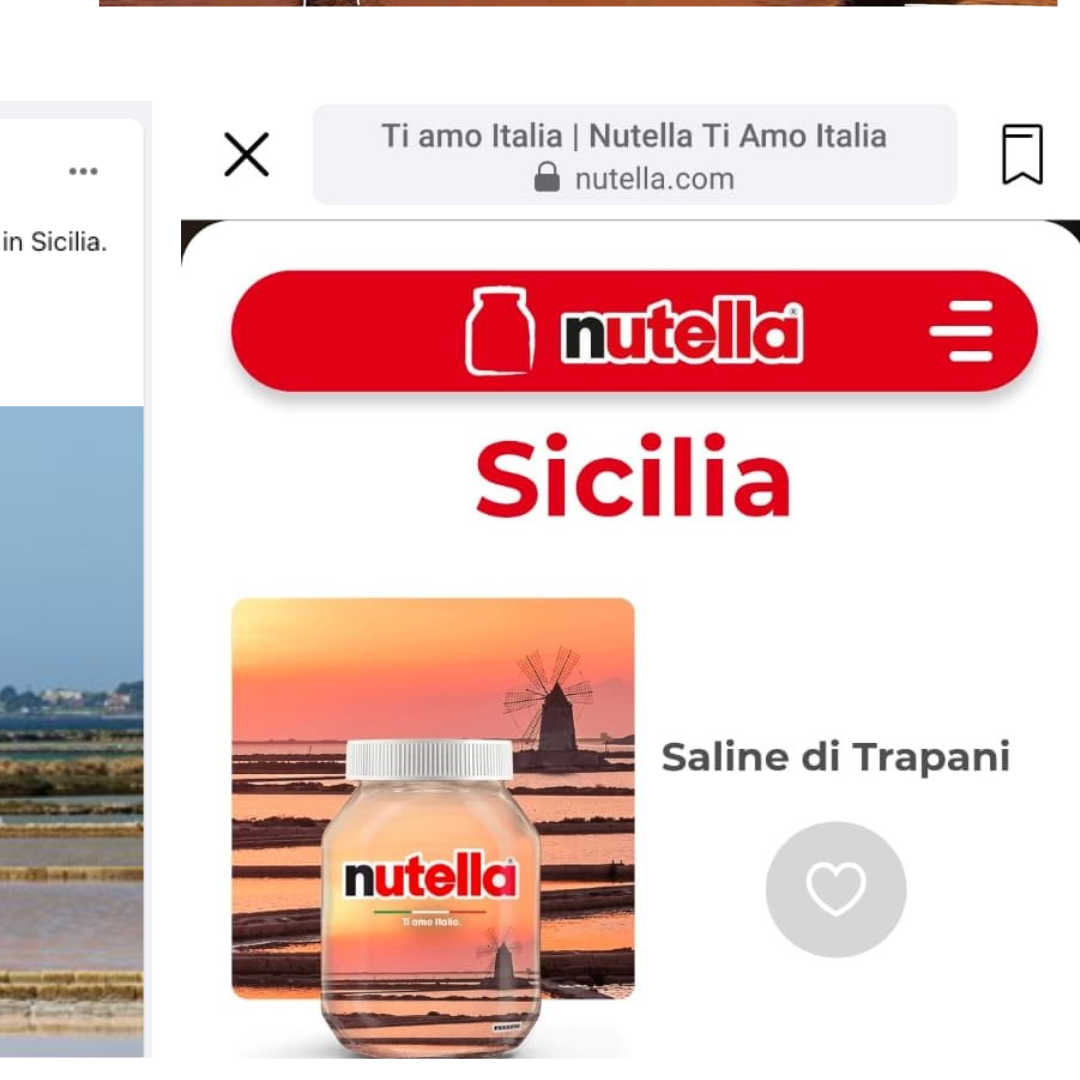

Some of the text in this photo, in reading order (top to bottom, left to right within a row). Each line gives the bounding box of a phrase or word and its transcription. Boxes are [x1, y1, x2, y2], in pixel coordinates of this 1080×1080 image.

[381, 121, 887, 148] Ti amo Italia Nutella Ti Amo Italia
[576, 165, 734, 190] nutella.com
[3, 230, 23, 252] in
[31, 230, 107, 252] Sicilia.
[565, 300, 799, 360] nutella
[475, 431, 790, 519] Sicilia
[662, 738, 1010, 780] Saline di Trapani
[345, 852, 517, 897] nutella
